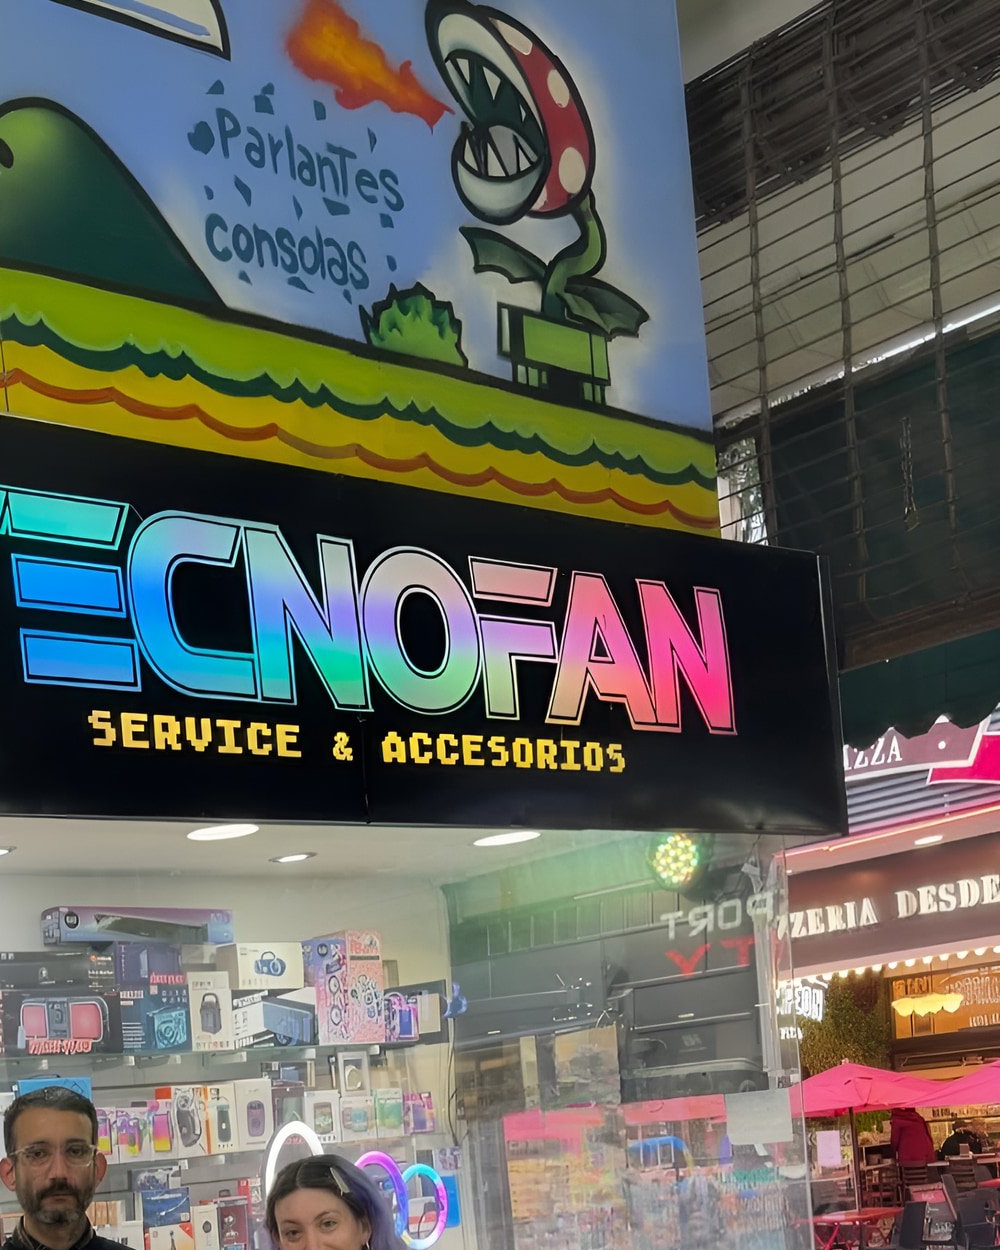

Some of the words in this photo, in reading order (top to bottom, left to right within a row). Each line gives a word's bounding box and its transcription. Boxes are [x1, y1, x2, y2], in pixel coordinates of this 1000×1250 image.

[87, 709, 302, 760] SERVICE
[332, 732, 354, 763] &
[380, 730, 626, 774] ACCESORIOS
[894, 873, 1000, 919] DESDE
